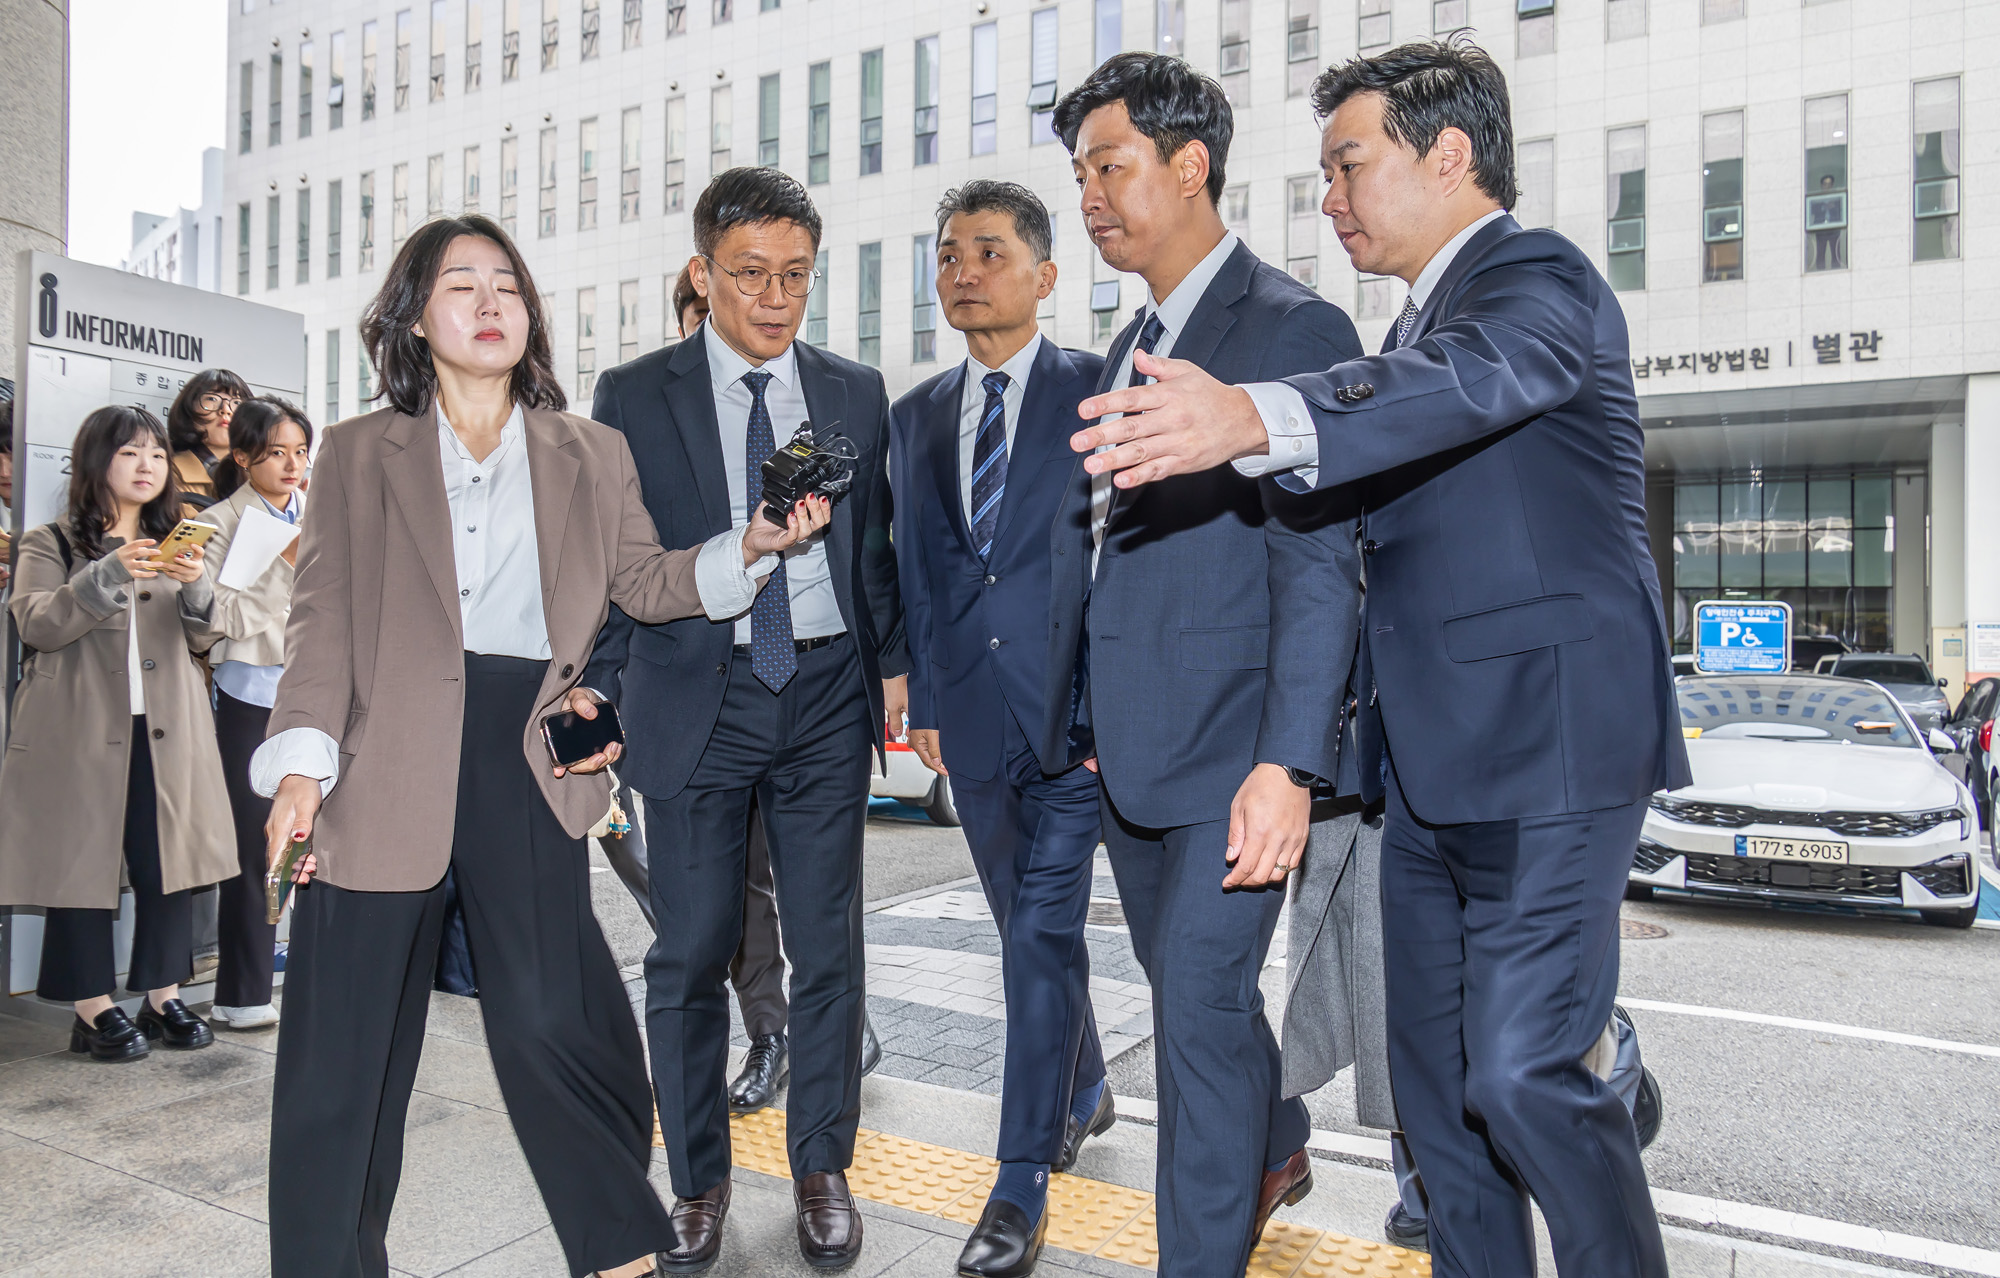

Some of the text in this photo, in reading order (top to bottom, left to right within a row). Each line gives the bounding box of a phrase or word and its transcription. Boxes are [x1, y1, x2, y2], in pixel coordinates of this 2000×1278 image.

[66, 310, 203, 363] INFORMATION
[1631, 330, 1883, 378] 남부지방법원 별관
[59, 356, 66, 377] 1
[60, 455, 72, 475] 2
[1720, 622, 1741, 647] P
[1799, 843, 1843, 861] 6903
